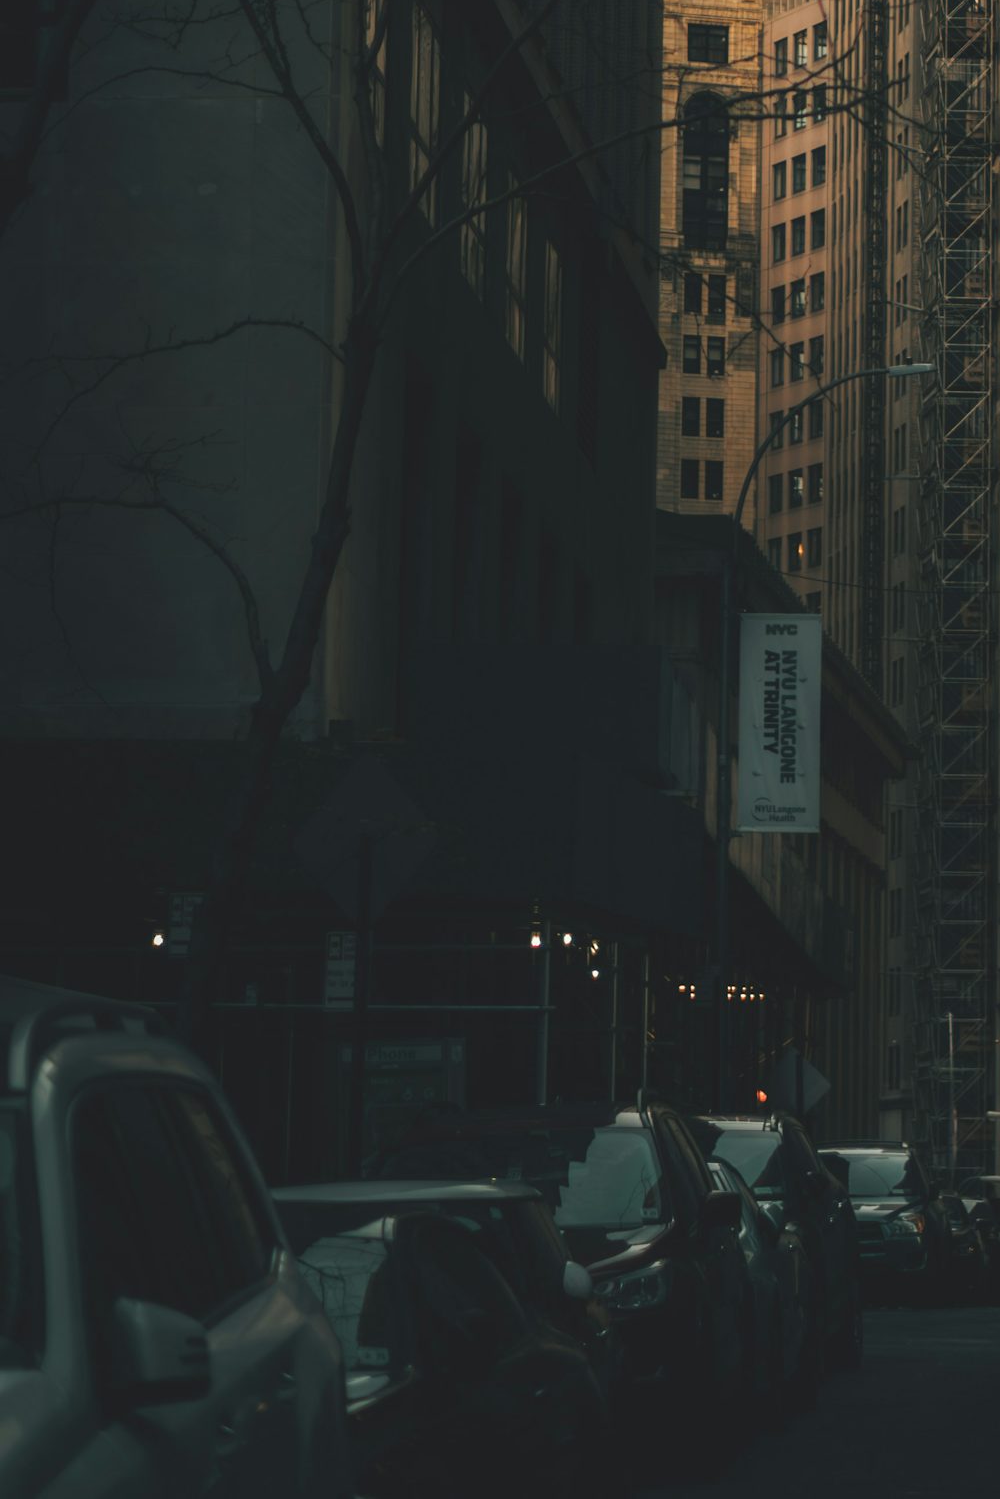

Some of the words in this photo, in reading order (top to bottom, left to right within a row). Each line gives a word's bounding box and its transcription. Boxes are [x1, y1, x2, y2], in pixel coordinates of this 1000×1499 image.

[765, 624, 798, 636] NYC
[764, 650, 781, 675] AT
[780, 650, 798, 689] NYU
[763, 678, 780, 755] TRINITY
[779, 694, 798, 784] LANGONE
[768, 812, 796, 822] Health
